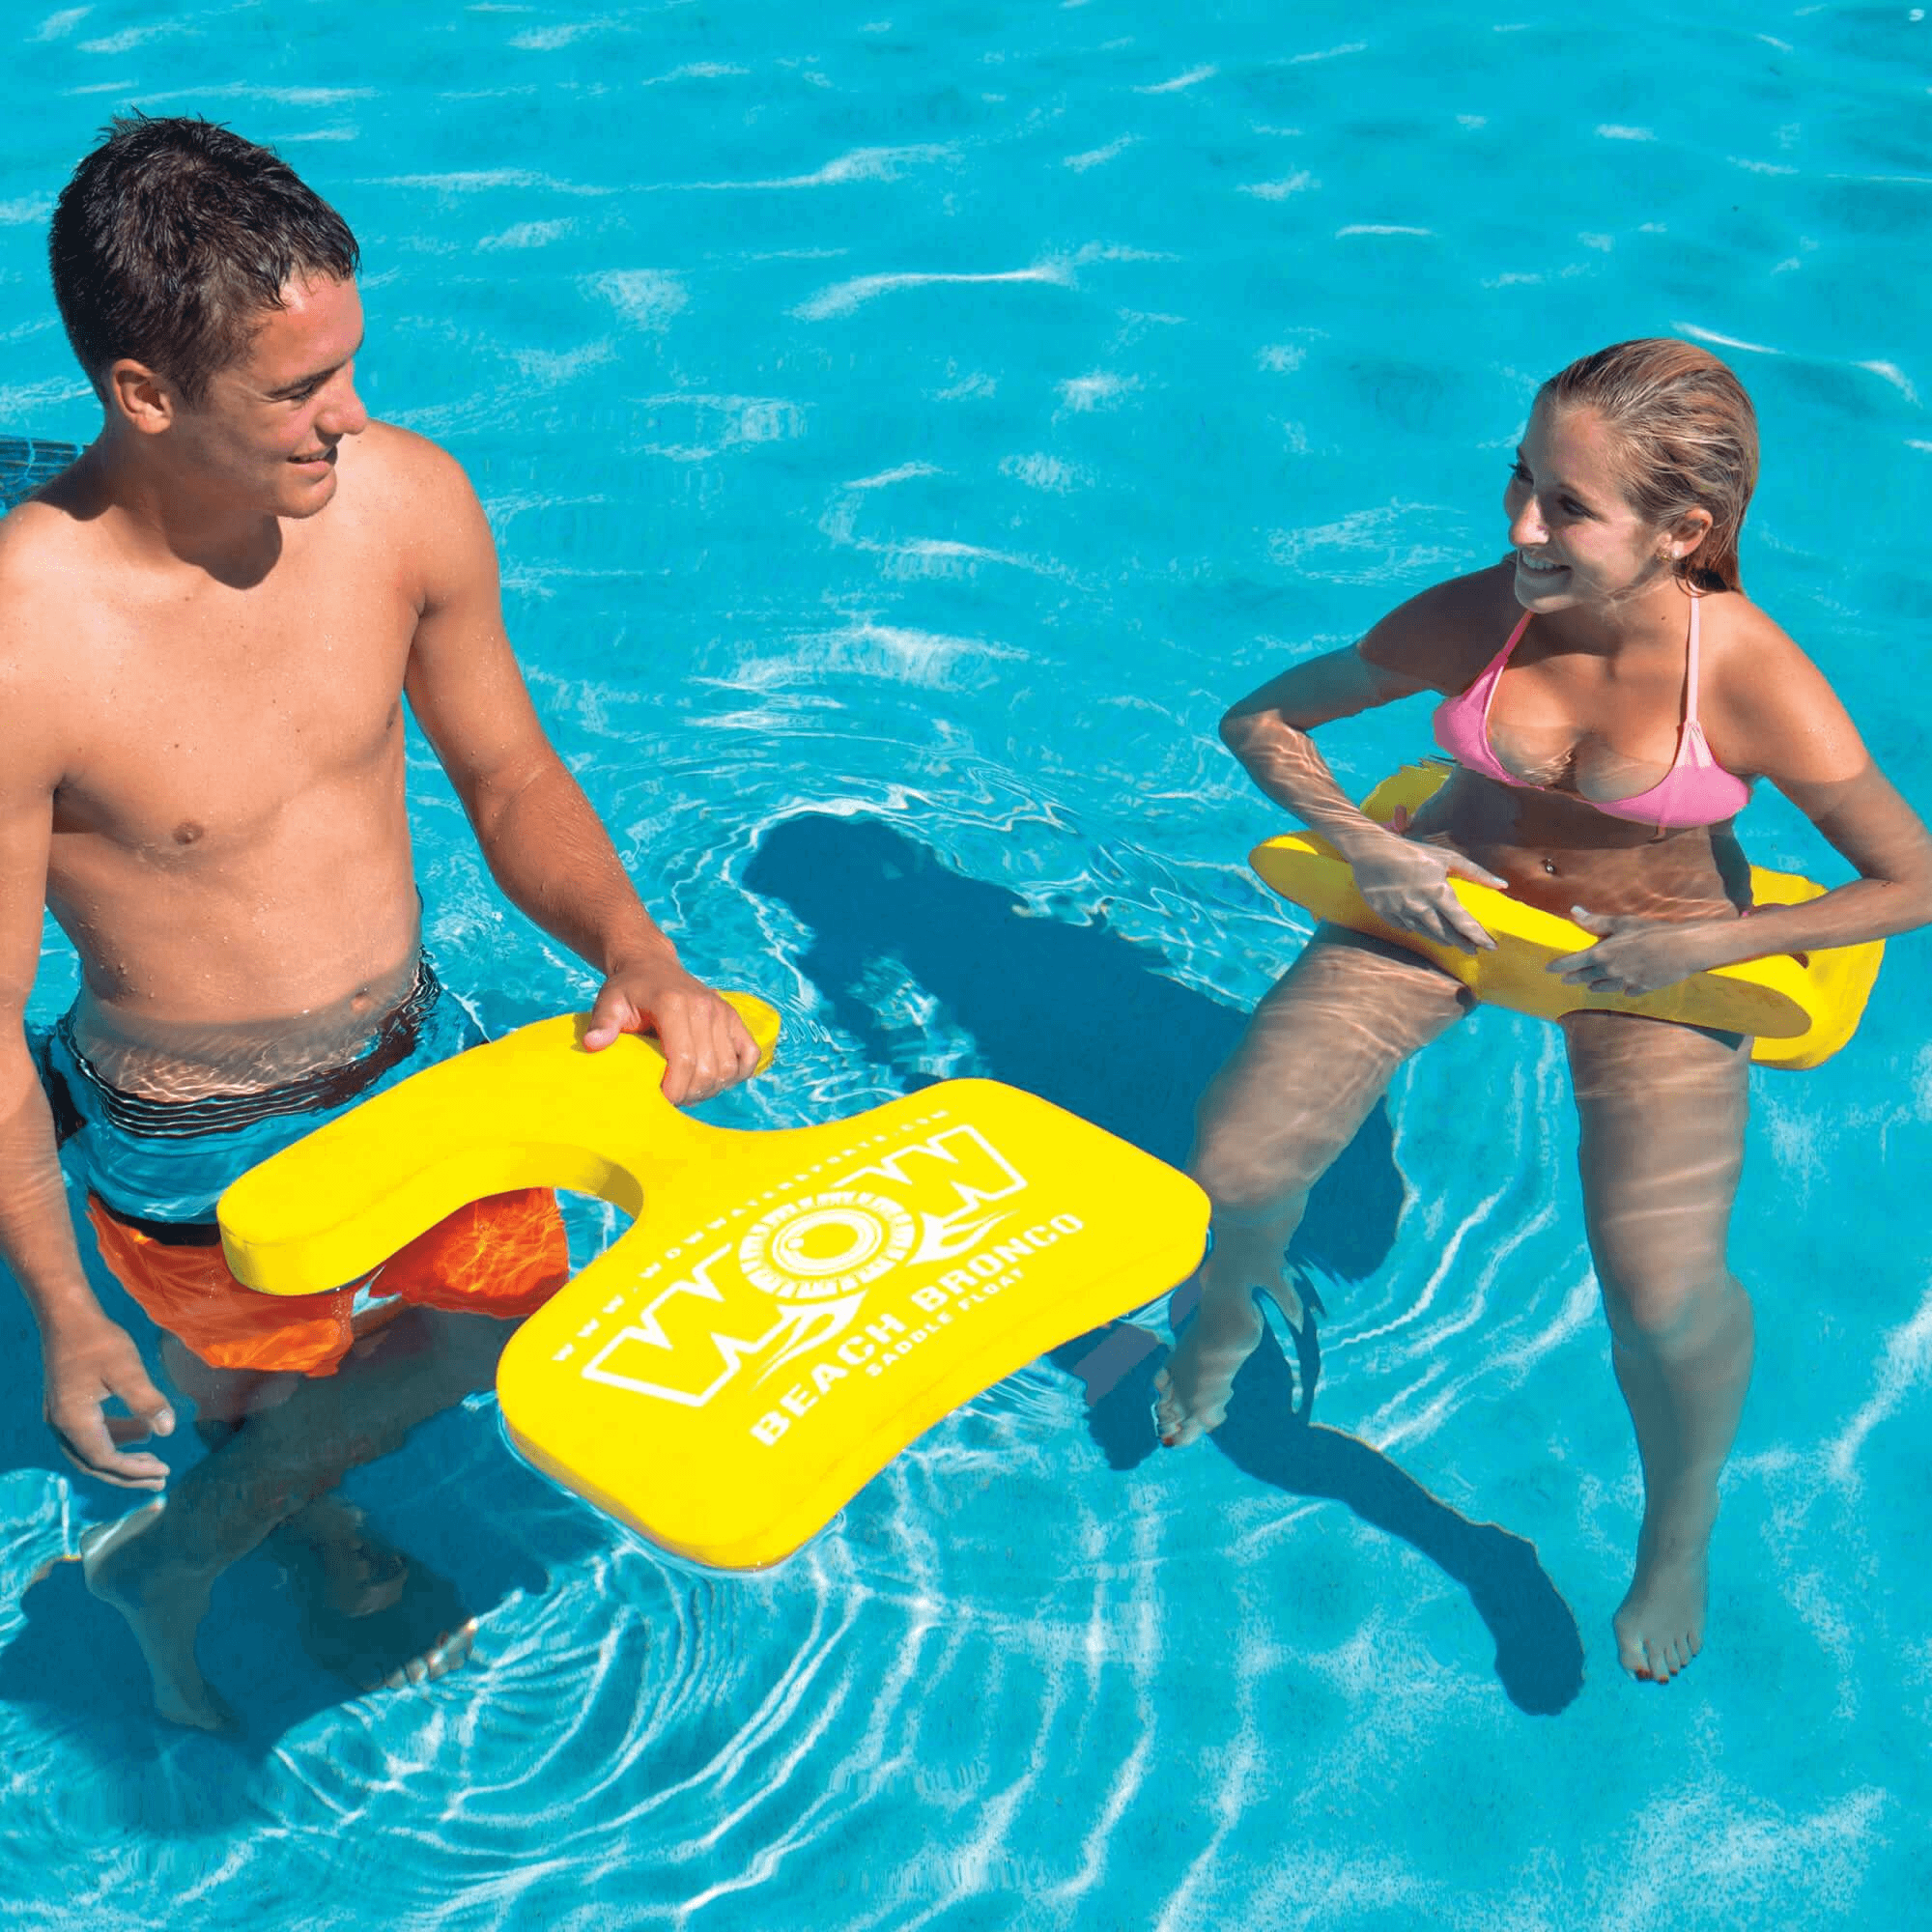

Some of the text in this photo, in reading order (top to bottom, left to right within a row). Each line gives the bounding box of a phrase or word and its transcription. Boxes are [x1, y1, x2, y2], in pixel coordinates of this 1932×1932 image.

[749, 1213, 1084, 1447] BEACH BRONCO
[865, 1267, 1024, 1378] SADDLE FLOAT
